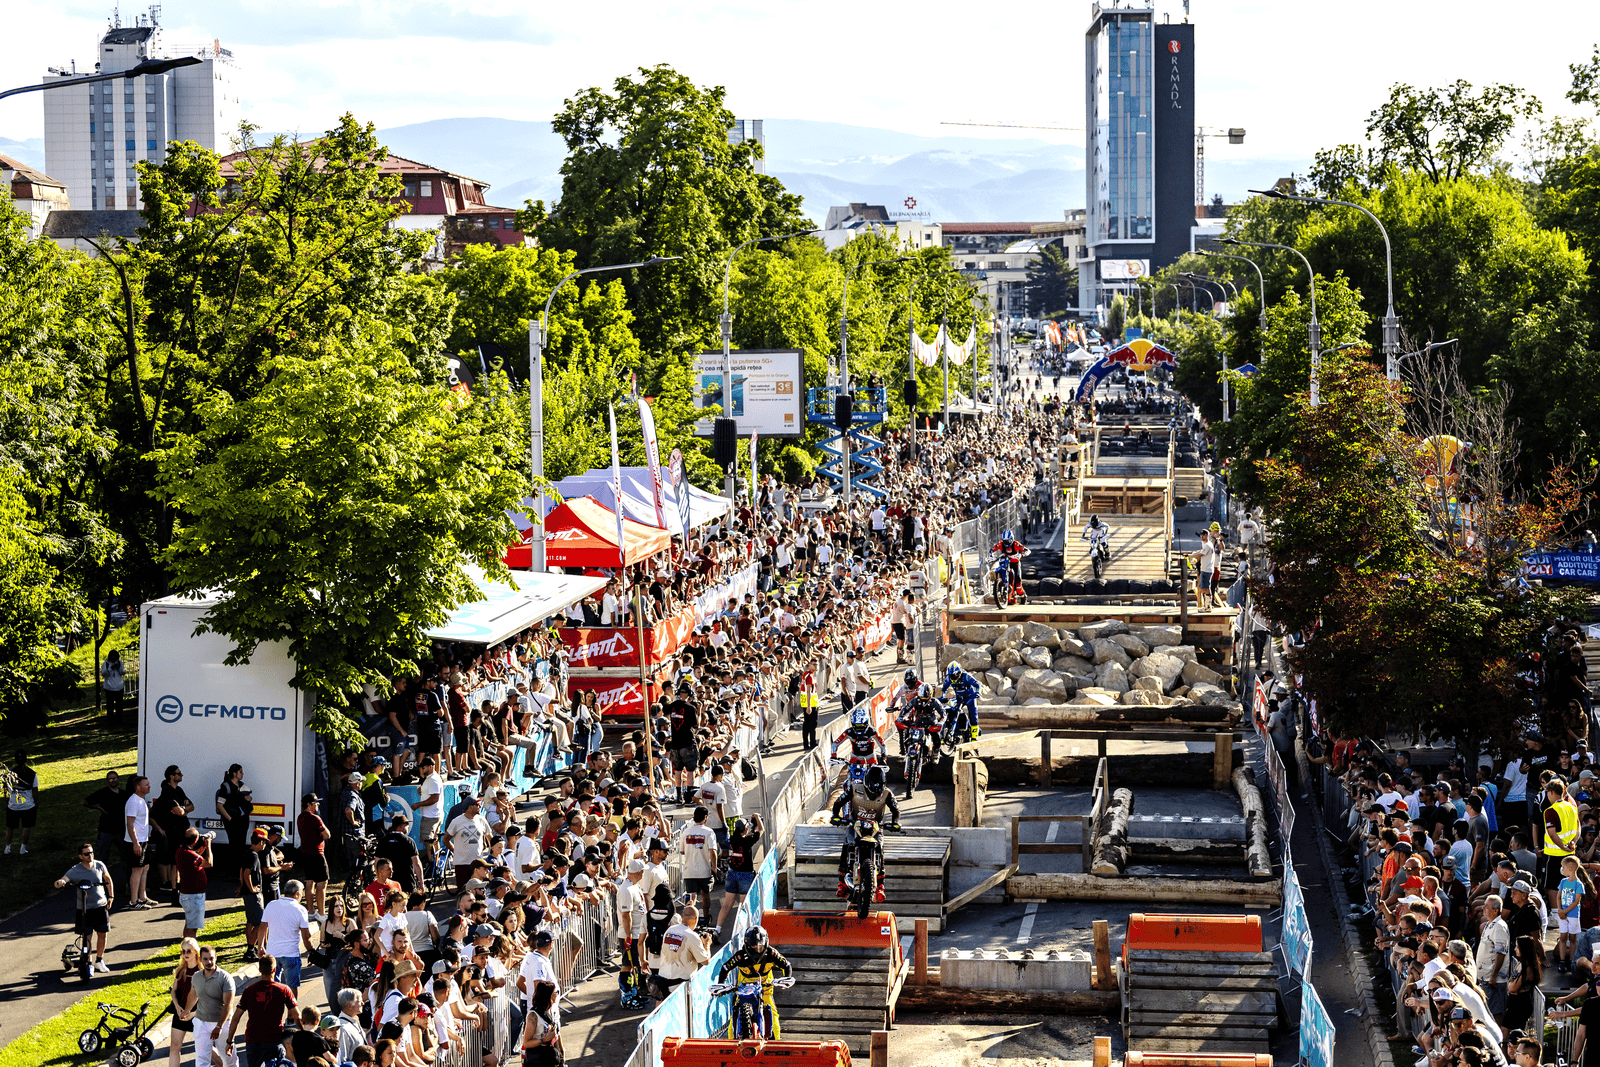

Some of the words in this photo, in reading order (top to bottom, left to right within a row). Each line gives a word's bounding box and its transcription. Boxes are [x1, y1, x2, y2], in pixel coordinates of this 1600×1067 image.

[1170, 56, 1180, 108] RAMADA
[1558, 561, 1598, 570] ADDITIVES
[1559, 568, 1576, 576] CAR
[1577, 569, 1597, 577] CARE
[568, 635, 618, 662] LEATT
[189, 703, 286, 721] CFMOTO
